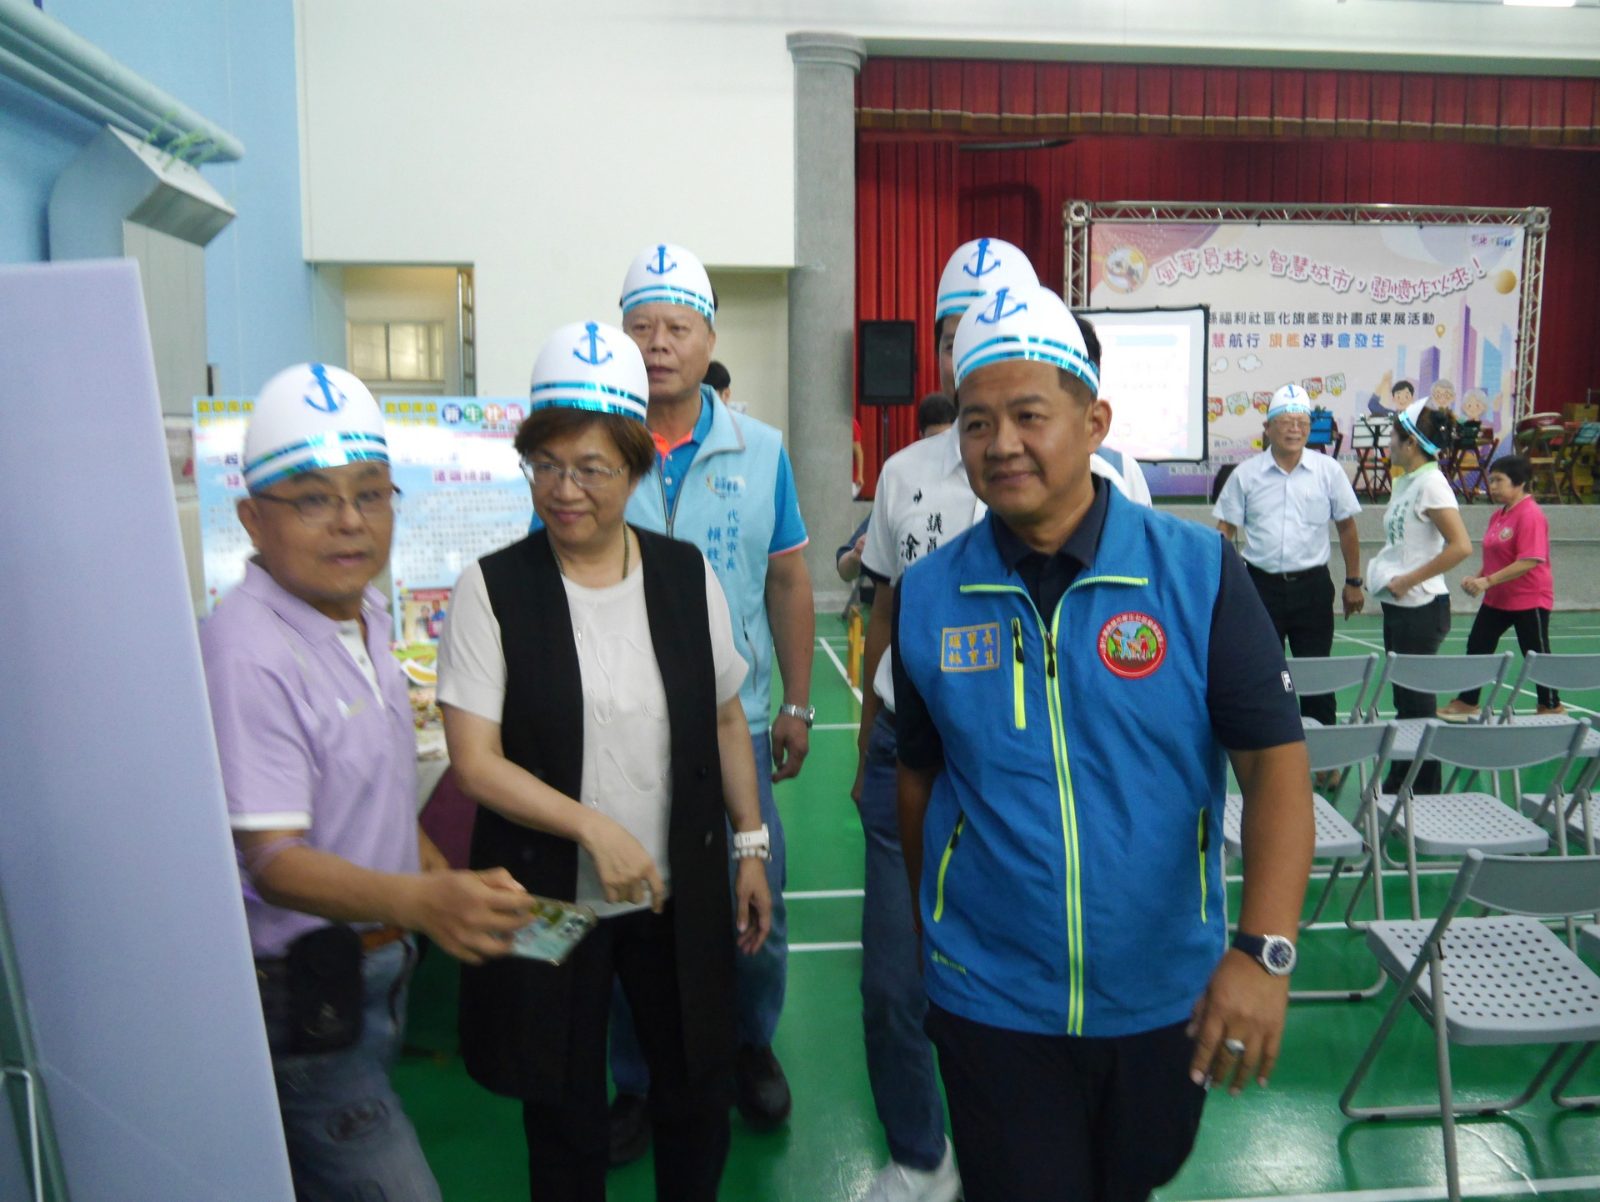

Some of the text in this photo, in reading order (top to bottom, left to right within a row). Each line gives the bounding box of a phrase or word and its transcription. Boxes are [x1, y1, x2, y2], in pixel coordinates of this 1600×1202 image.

[1269, 332, 1385, 348] 旗艦好事會發生
